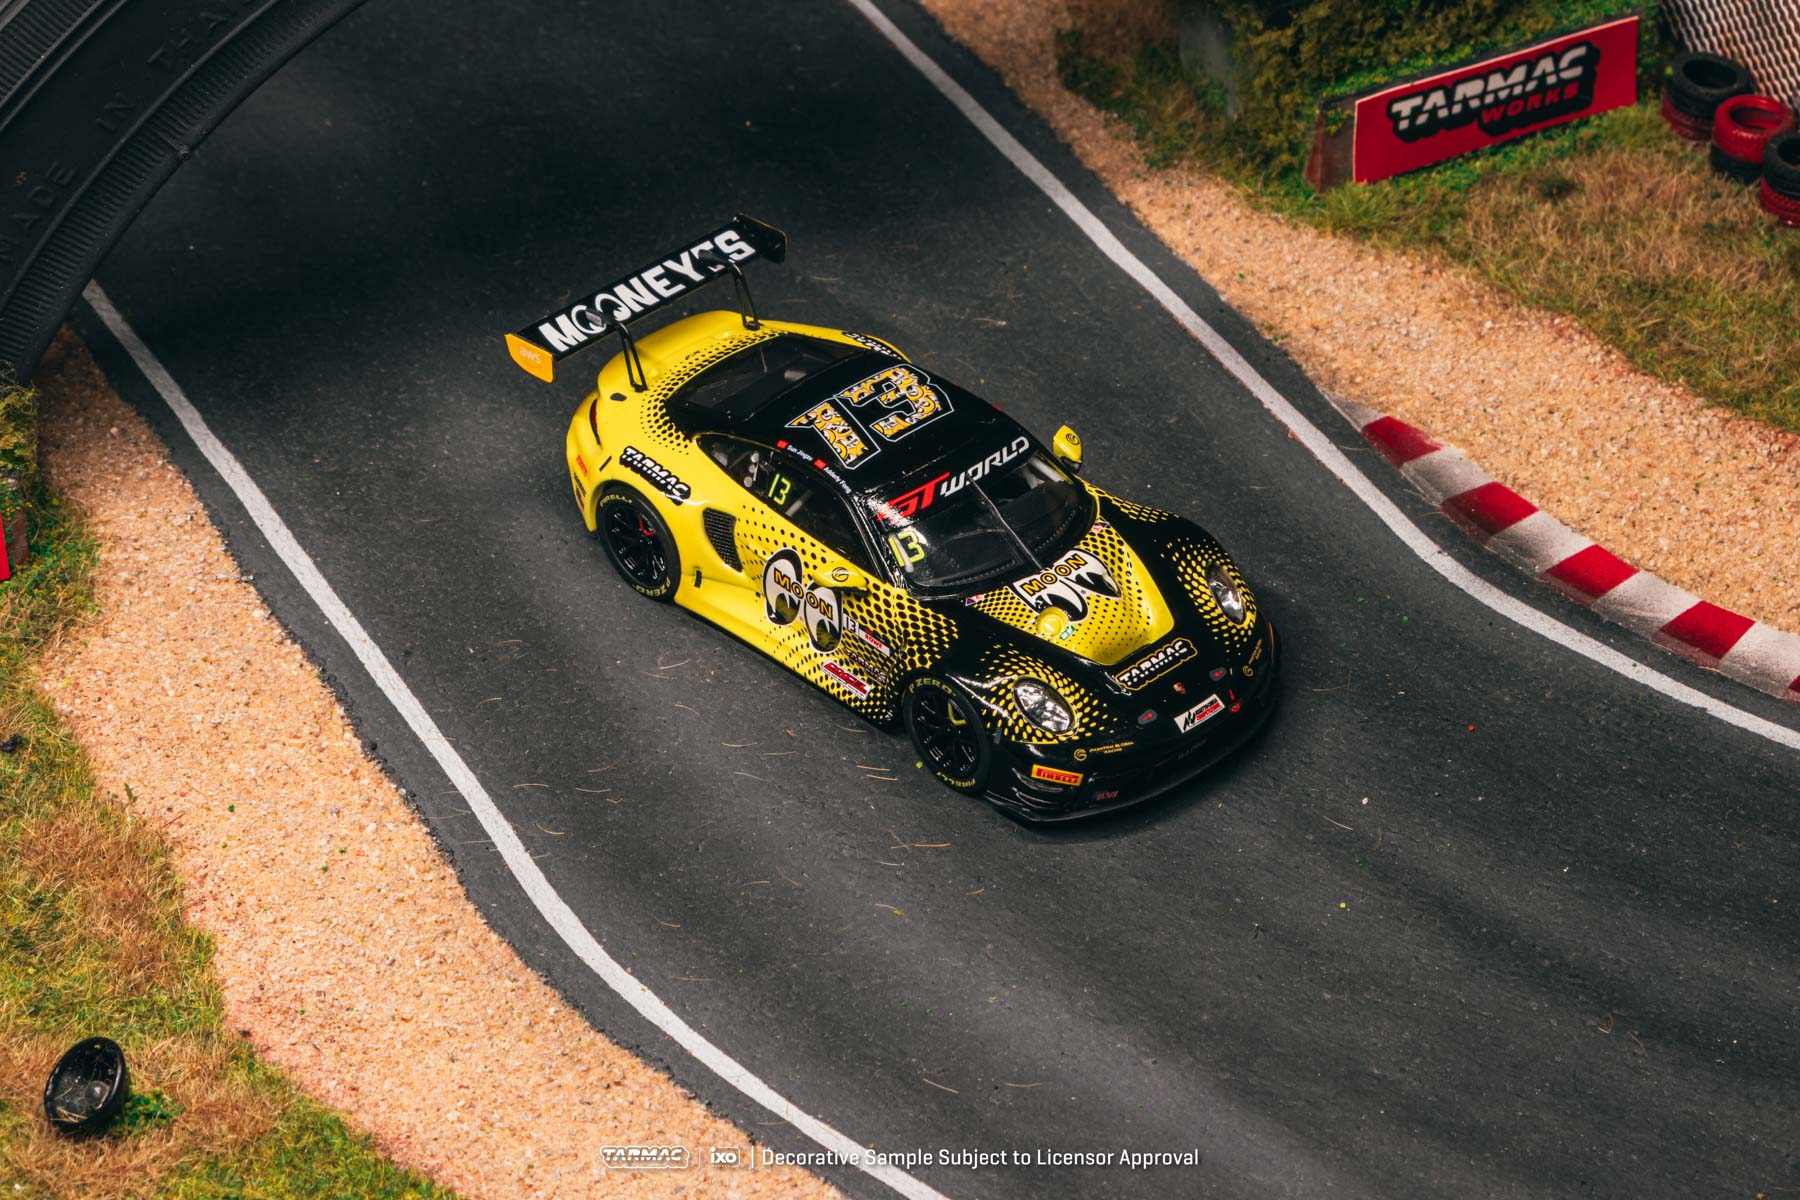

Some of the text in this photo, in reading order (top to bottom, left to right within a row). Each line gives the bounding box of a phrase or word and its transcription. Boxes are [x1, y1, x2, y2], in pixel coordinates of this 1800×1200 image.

[1391, 46, 1587, 131] TARMAC
[1481, 82, 1580, 125] WORKS
[95, 92, 136, 133] IN
[520, 346, 541, 365] aws
[785, 364, 954, 470] 13
[621, 446, 689, 497] TARMAC
[940, 436, 1029, 497] WORLD
[768, 473, 791, 505] 13
[888, 530, 925, 567] 13
[774, 567, 833, 620] MOON
[1020, 553, 1088, 597] MOON
[846, 616, 857, 632] 13
[1119, 641, 1188, 686] TARMAC
